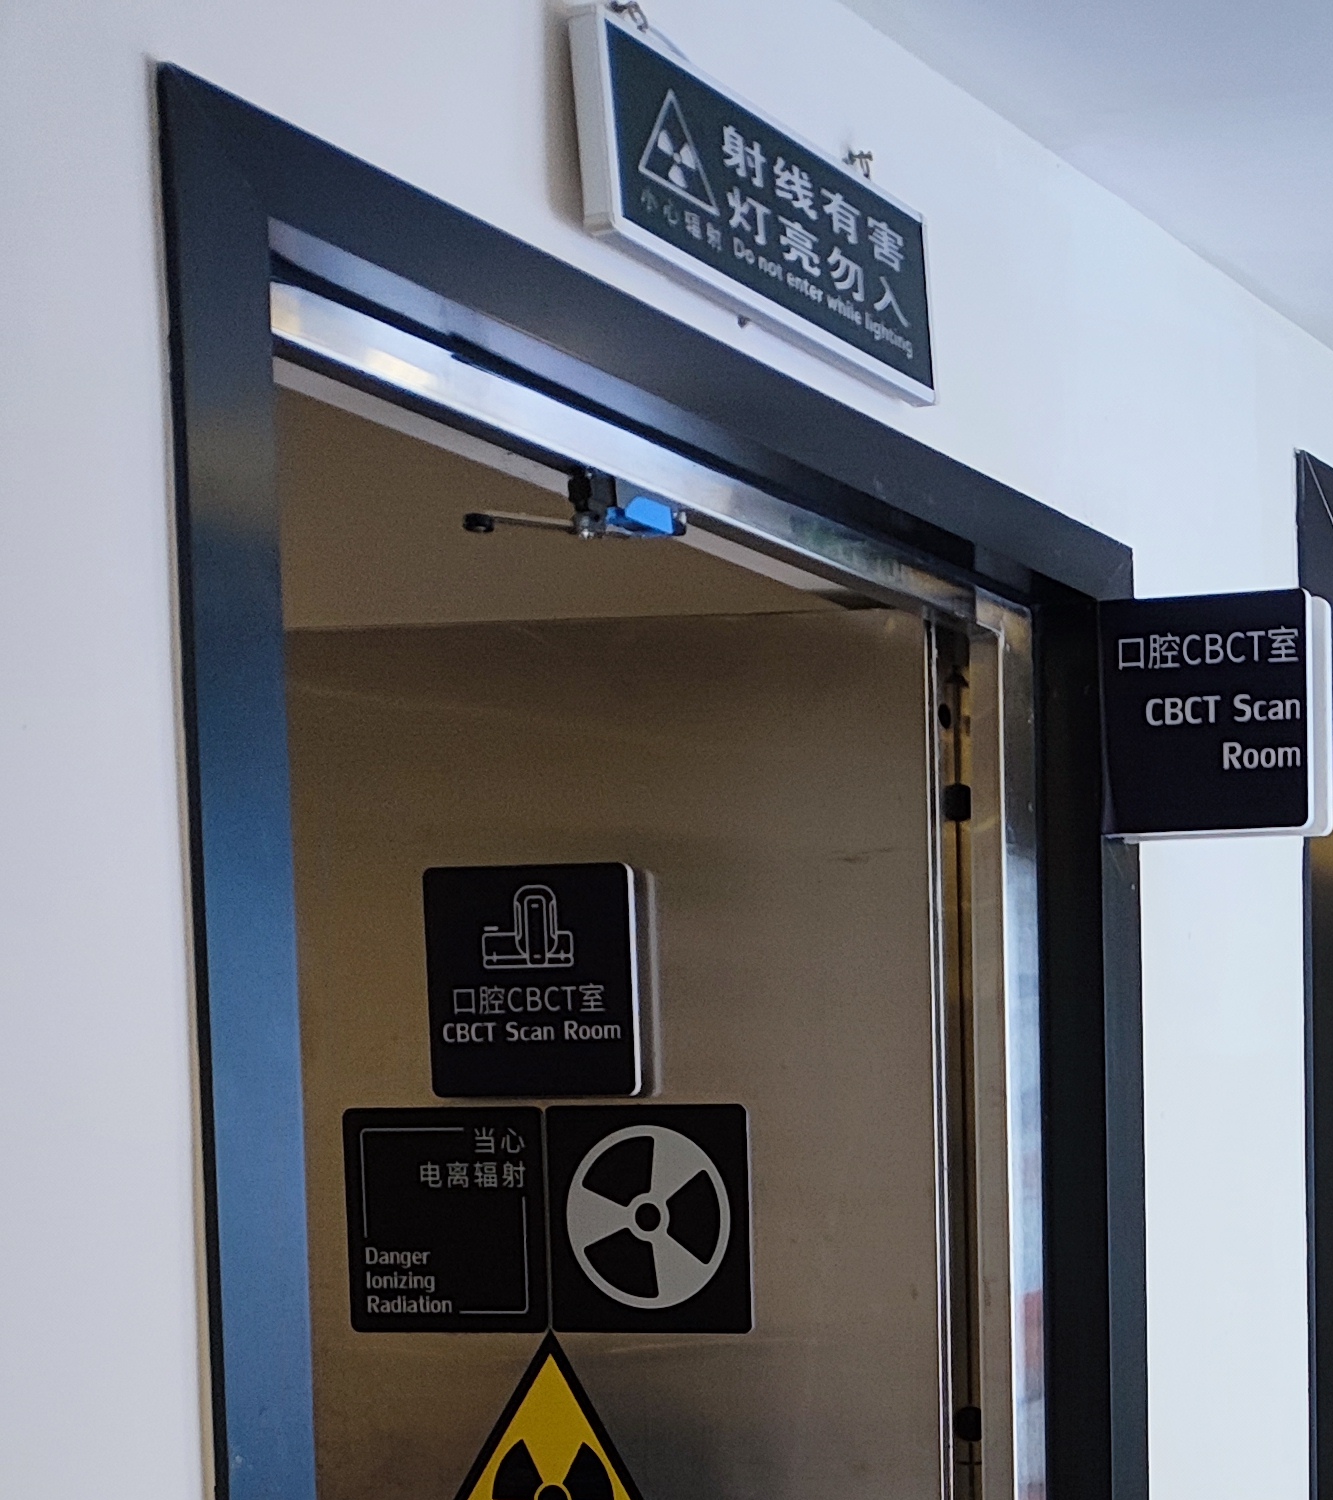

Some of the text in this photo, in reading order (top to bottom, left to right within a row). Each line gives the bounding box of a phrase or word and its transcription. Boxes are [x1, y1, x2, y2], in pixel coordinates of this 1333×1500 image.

[722, 124, 905, 272] 射线有害
[727, 186, 910, 328] 灯亮勿入
[733, 236, 913, 359] Do not enter while lighting
[1117, 625, 1299, 670] 口腔CBCT室
[1145, 693, 1300, 726] CBCT Scan
[1222, 741, 1301, 770] Room
[452, 982, 606, 1017] 口腔CBCT室
[442, 1020, 622, 1043] CBCT Scan Room
[473, 1127, 526, 1155] 当心
[419, 1161, 526, 1190] 电离辐射
[364, 1246, 431, 1268] Danger
[365, 1270, 436, 1294] Ionizing
[366, 1295, 453, 1315] Radiation
